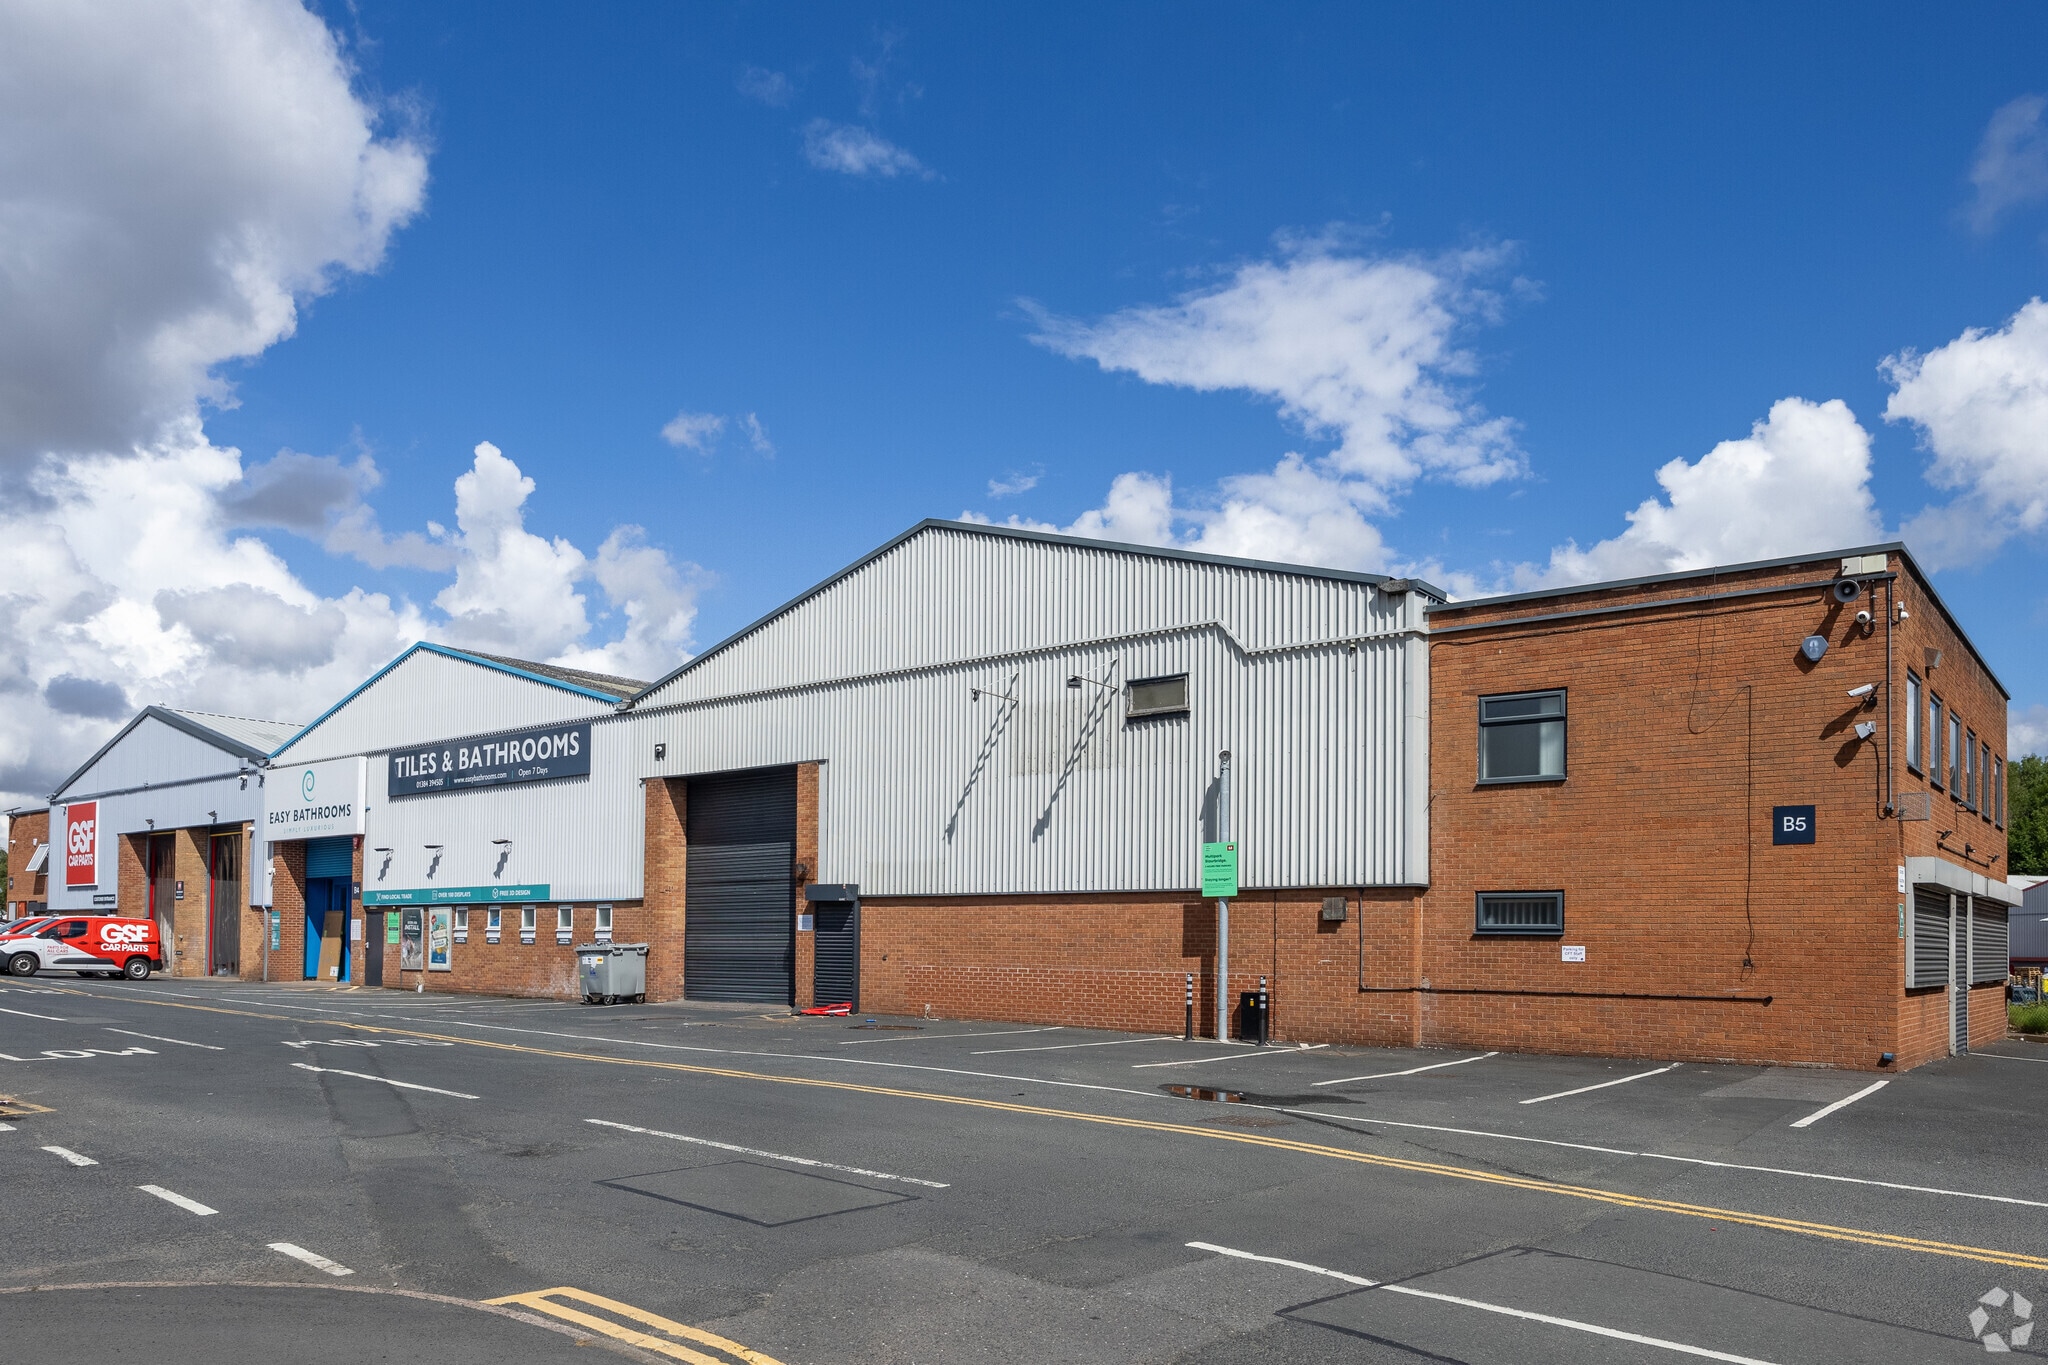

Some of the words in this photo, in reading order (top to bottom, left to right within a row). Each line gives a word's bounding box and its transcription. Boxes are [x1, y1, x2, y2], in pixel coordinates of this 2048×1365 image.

[395, 752, 437, 778] TILES
[441, 750, 454, 773] &
[459, 731, 580, 770] BATHROOMS
[518, 768, 532, 778] Open
[536, 766, 548, 775] Days
[270, 810, 290, 824] EASY
[294, 804, 352, 822] BATHROOMS
[304, 824, 335, 832] LUXURIOUS
[1784, 816, 1806, 832] B5
[68, 820, 94, 854] GSF
[68, 855, 78, 867] CAR
[78, 854, 94, 866] PARTS
[354, 886, 360, 894] B4
[100, 923, 149, 944] GSF
[100, 943, 121, 951] CAR
[121, 944, 149, 952] PARTS
